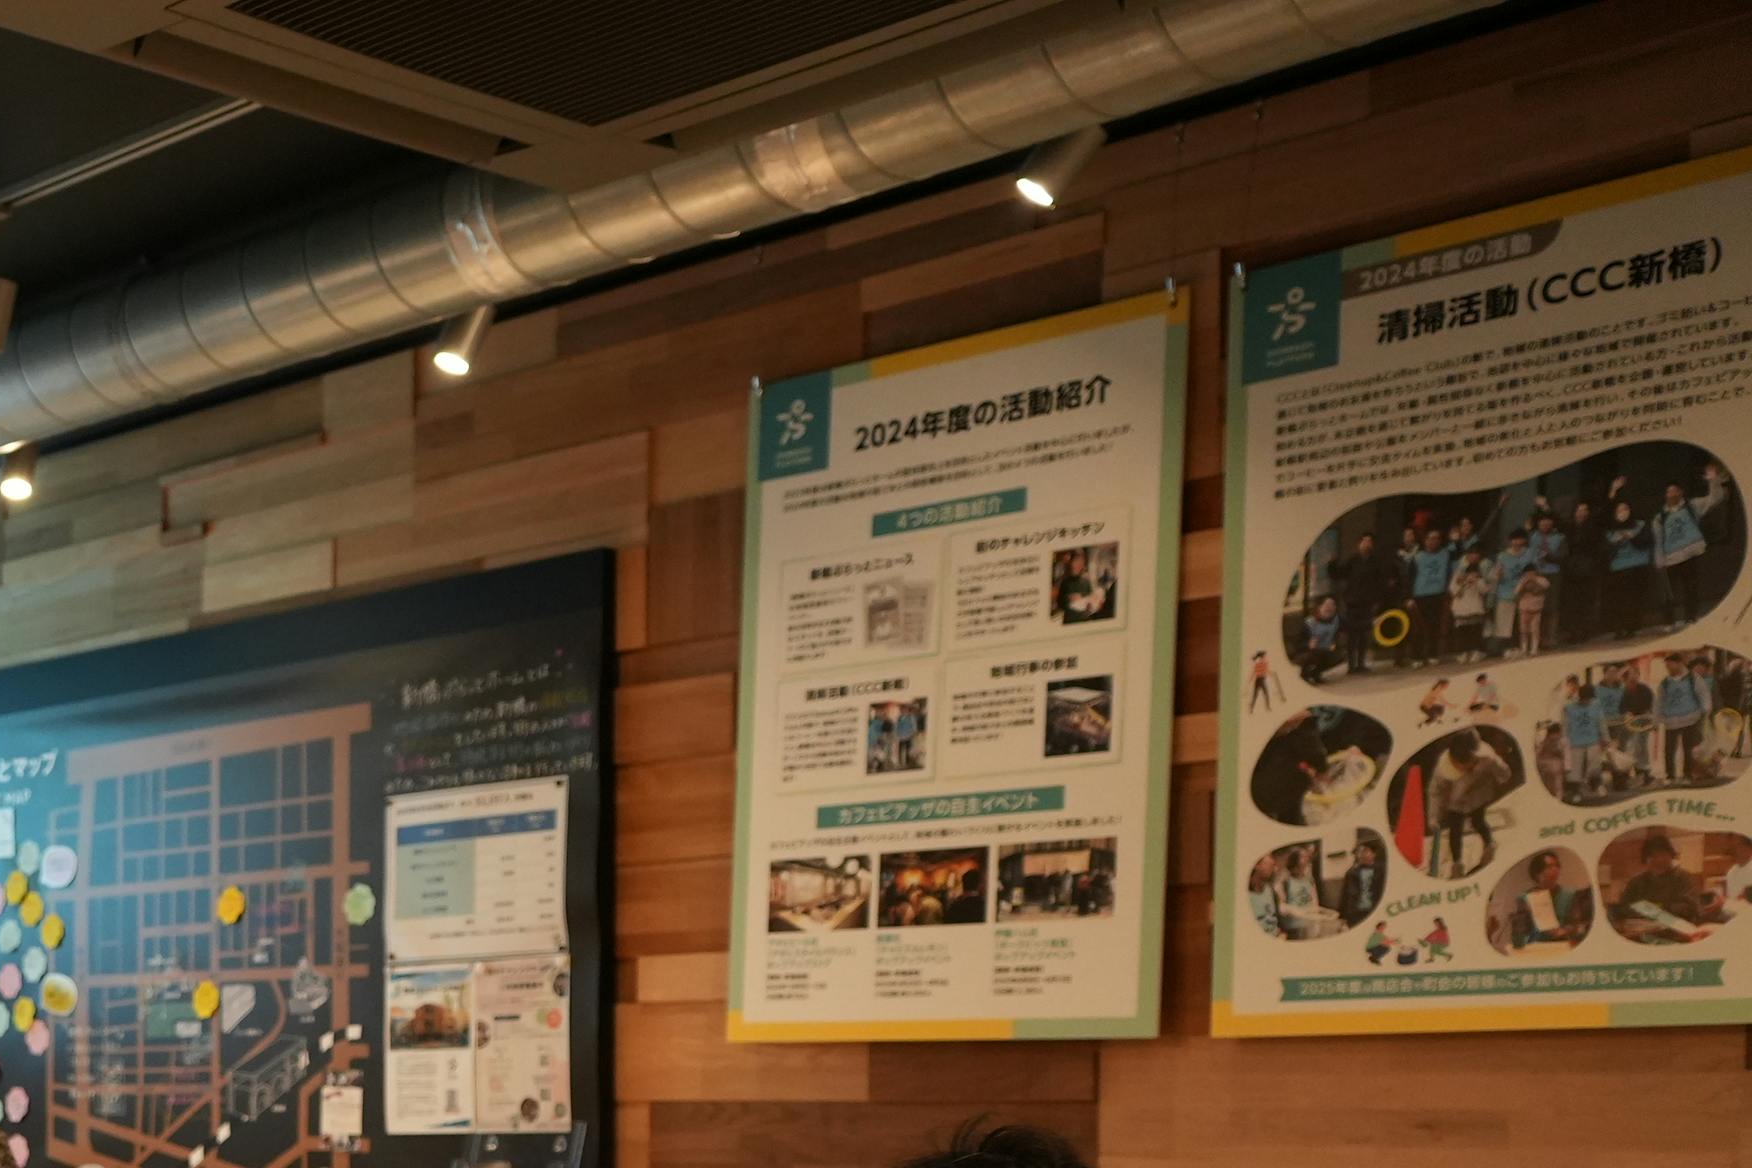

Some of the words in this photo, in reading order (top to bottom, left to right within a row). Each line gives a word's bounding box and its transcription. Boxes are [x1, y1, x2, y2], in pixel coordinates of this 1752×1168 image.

[1359, 232, 1534, 292] 2024年度の活動
[1376, 237, 1723, 346] 清掃活動（CCC新橋）
[854, 373, 1112, 452] 2024年度の活動紹介
[896, 496, 1003, 527] 4つの活動紹介
[1538, 820, 1576, 839] and
[1583, 801, 1659, 834] COFFEE
[1386, 891, 1444, 919] CLEAN
[1446, 882, 1482, 906] UP!
